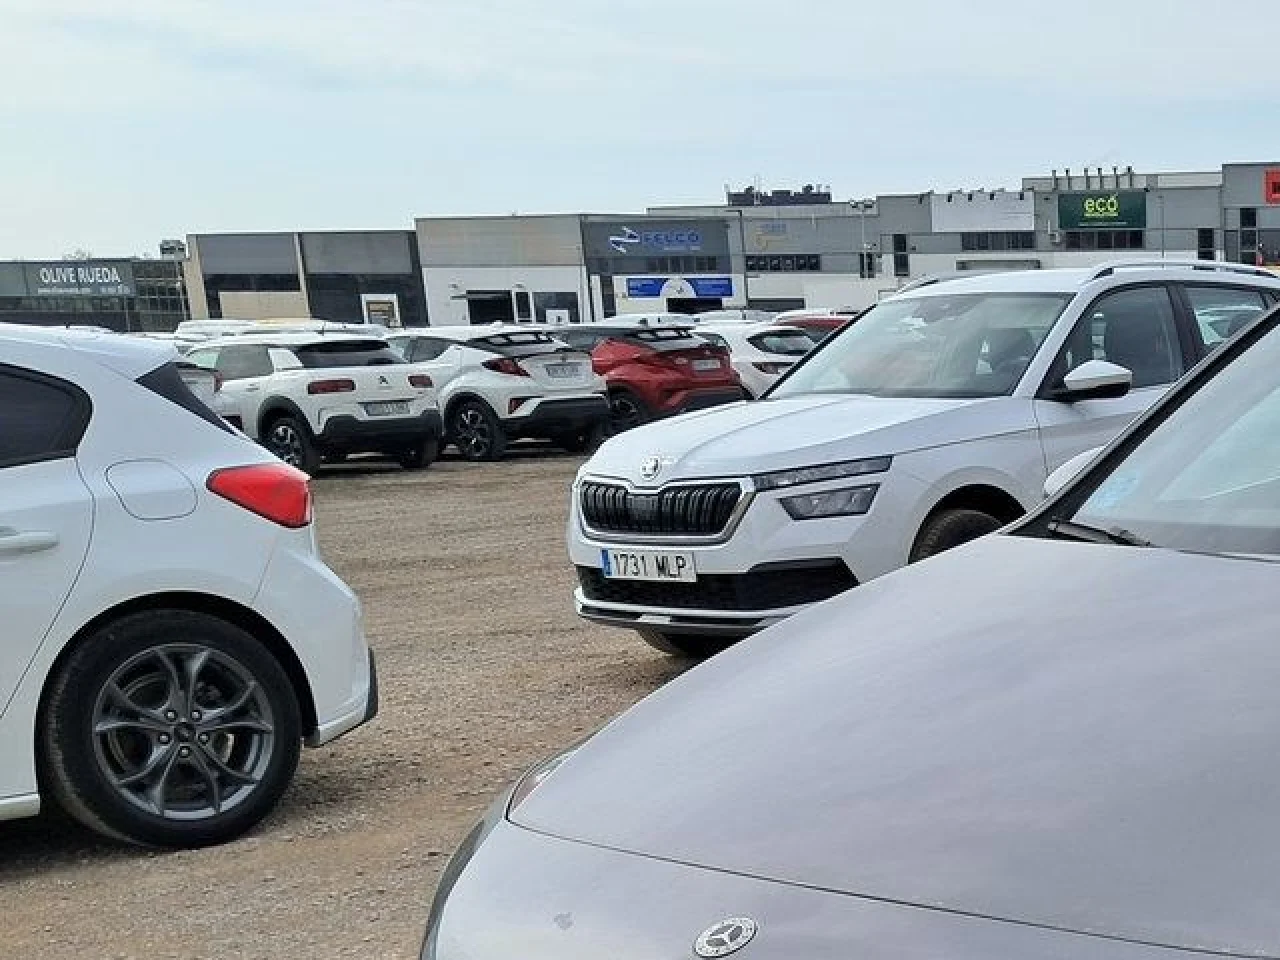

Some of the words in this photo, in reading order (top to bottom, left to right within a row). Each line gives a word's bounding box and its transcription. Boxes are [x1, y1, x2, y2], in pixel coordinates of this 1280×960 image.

[40, 267, 77, 283] OLIVE
[78, 267, 121, 283] RUEDA
[613, 553, 649, 576] 1731
[655, 555, 687, 578] MLP
